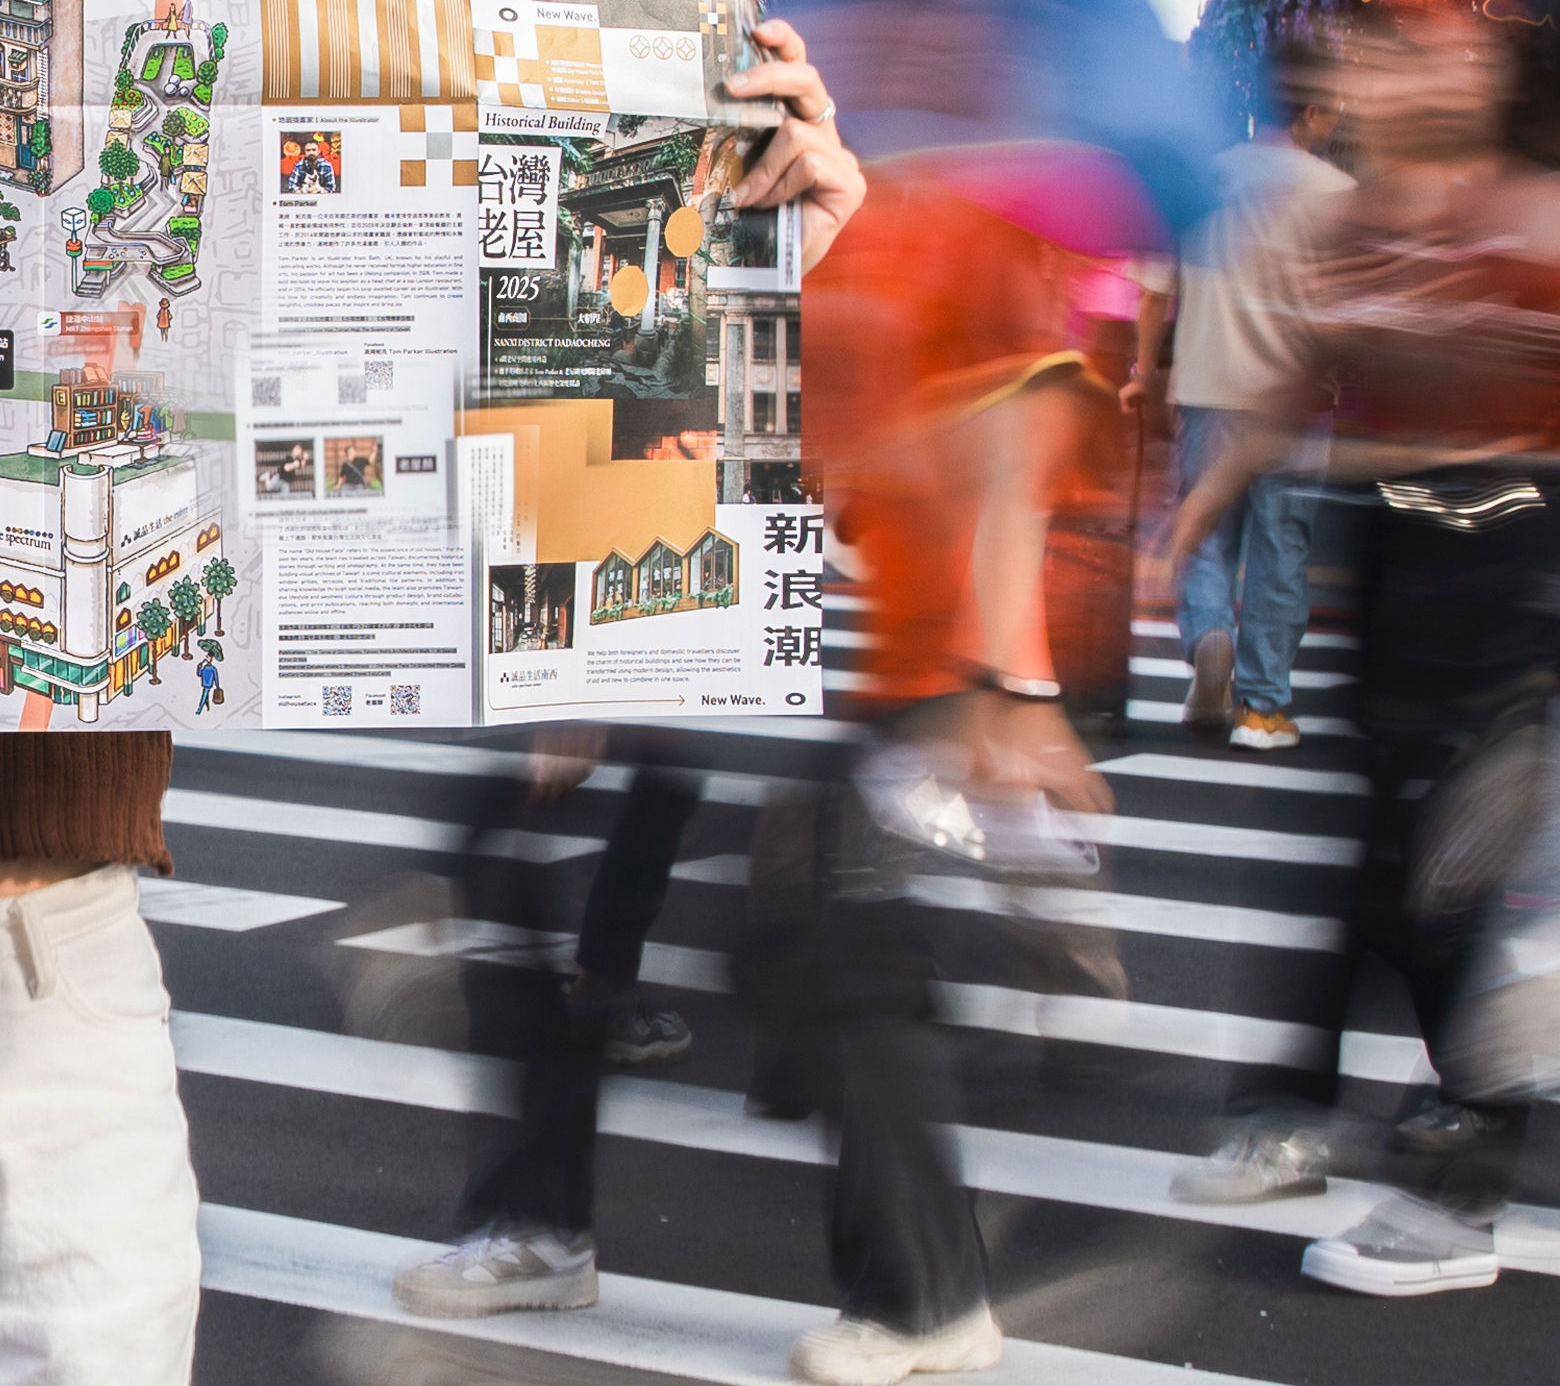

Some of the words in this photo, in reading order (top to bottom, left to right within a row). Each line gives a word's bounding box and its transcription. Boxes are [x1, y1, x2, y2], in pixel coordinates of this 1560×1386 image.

[537, 8, 562, 20] New
[564, 9, 597, 23] Wave.
[485, 112, 546, 129] Historical
[549, 116, 601, 135] Building
[478, 153, 550, 206] 台灣
[478, 207, 546, 260] 老屋
[496, 275, 541, 301] 2025
[5, 533, 51, 550] spectrum
[701, 694, 728, 705] New
[730, 694, 766, 705] Wave.
